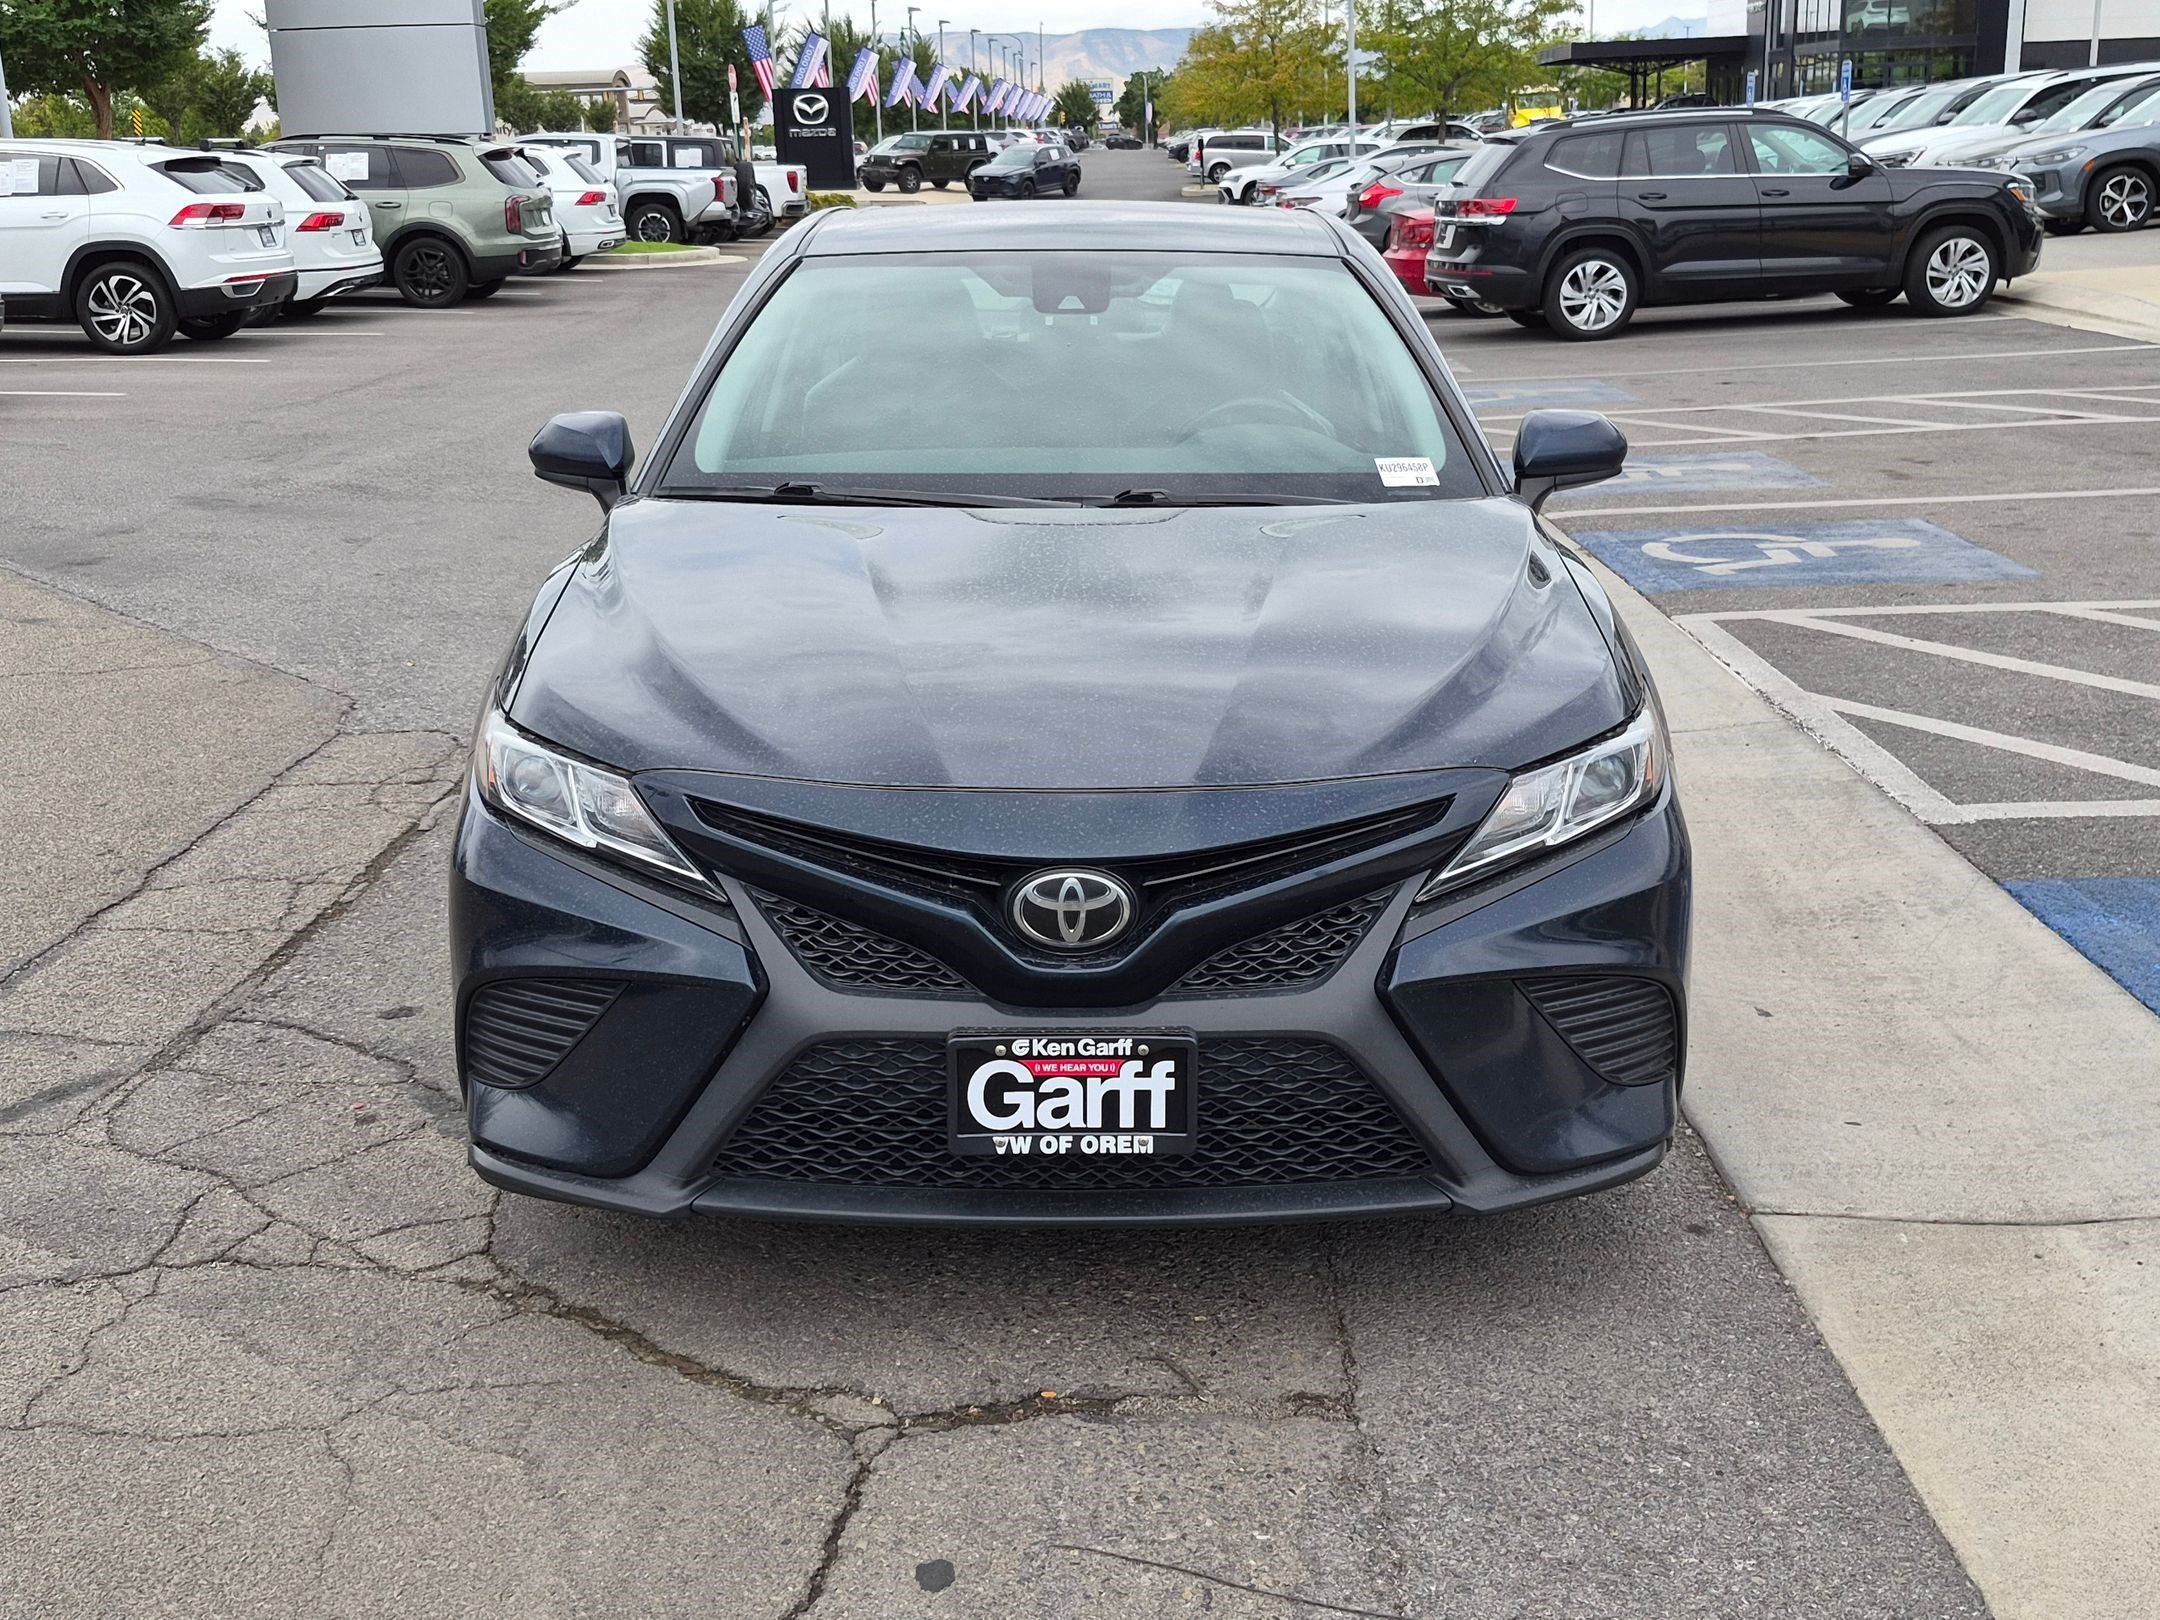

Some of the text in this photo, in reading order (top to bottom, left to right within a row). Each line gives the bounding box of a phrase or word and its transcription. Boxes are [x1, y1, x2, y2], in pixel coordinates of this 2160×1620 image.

[789, 127, 837, 138] mazda
[1032, 1039, 1075, 1056] Ken
[1078, 1038, 1133, 1056] Garff
[1042, 1063, 1110, 1072] WE HEAR YOU
[967, 1059, 1175, 1131] Garff
[992, 1135, 1154, 1154] VW OF OREM
